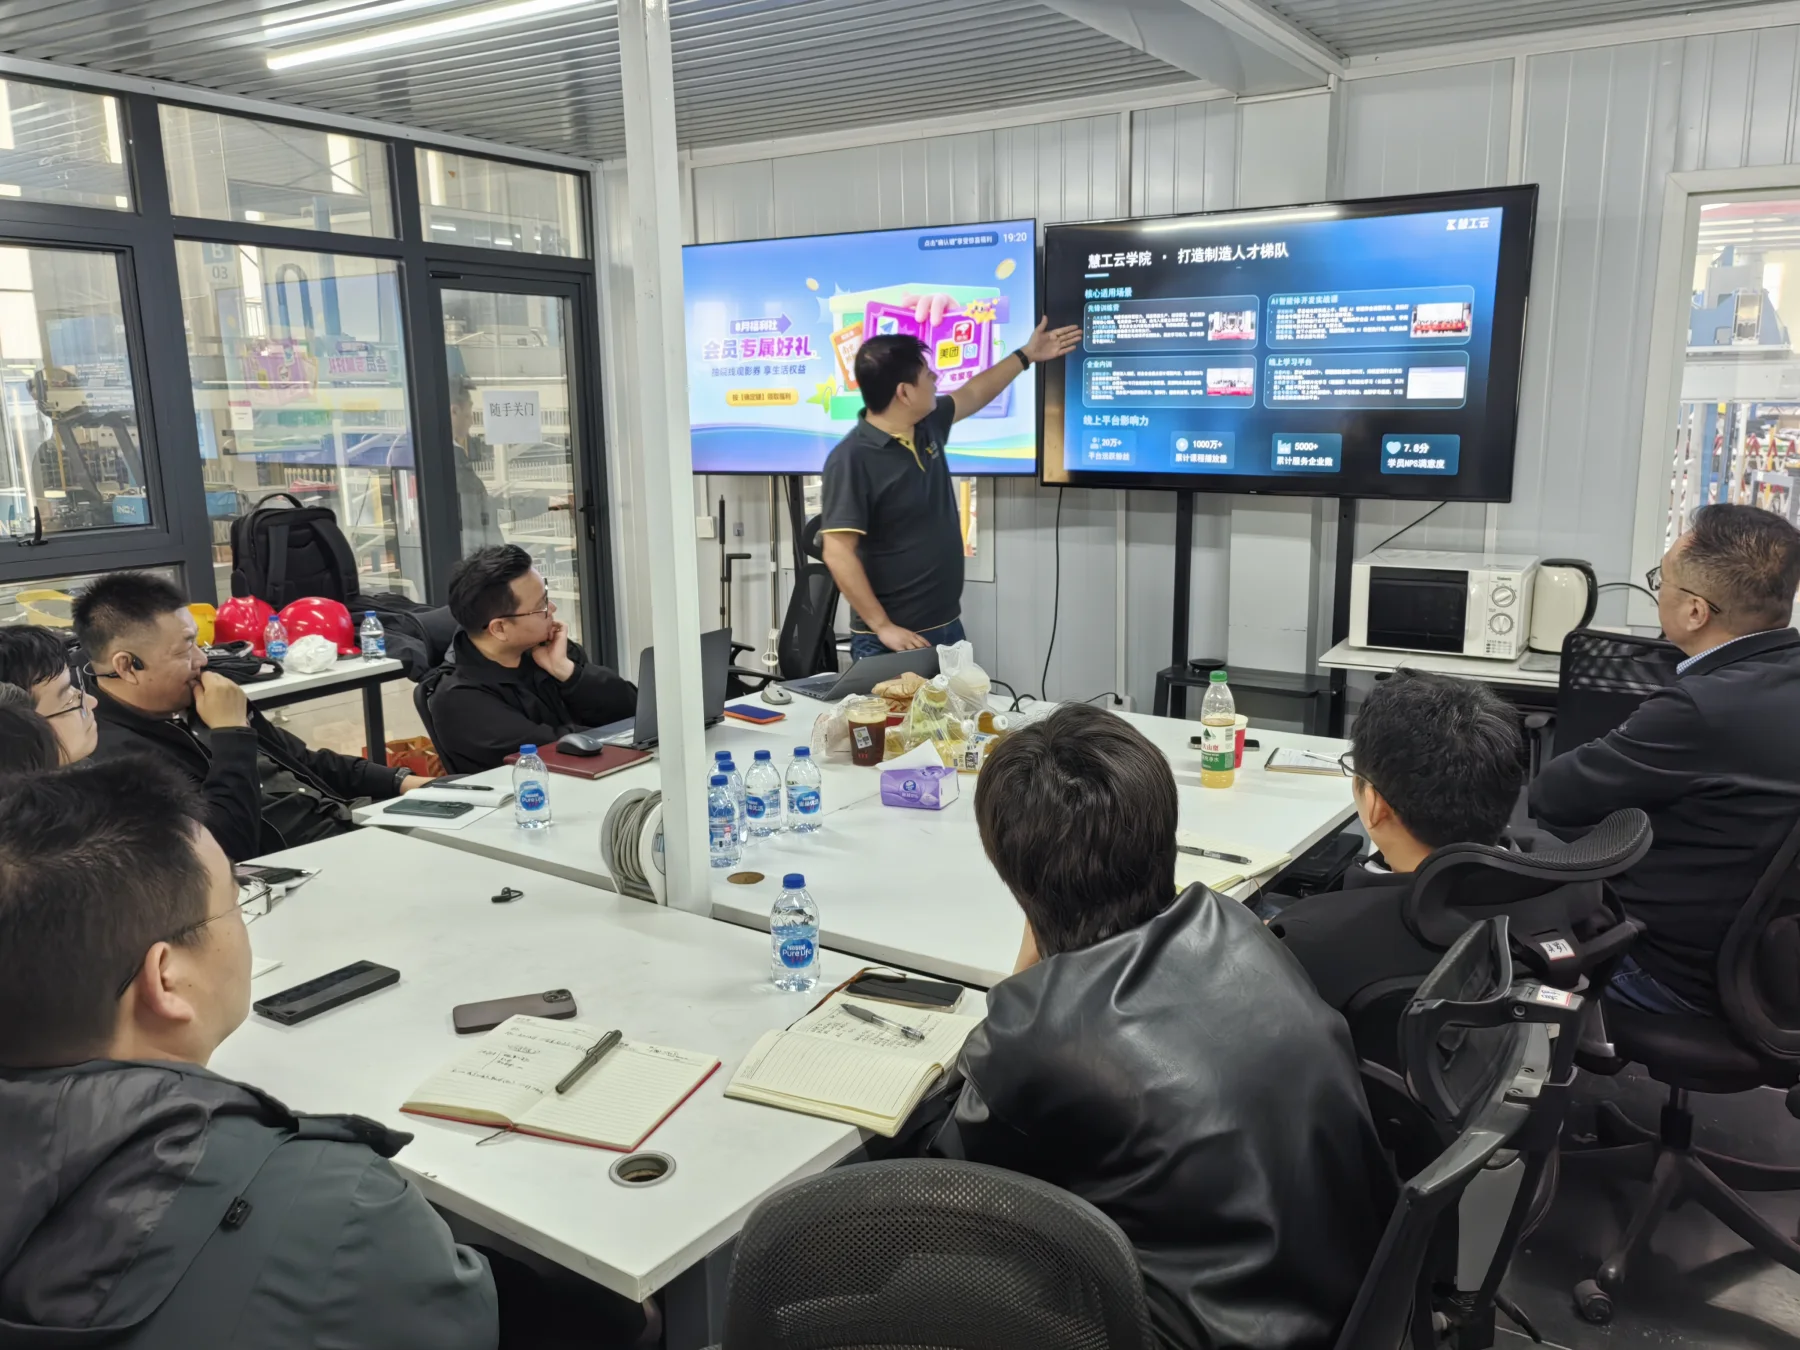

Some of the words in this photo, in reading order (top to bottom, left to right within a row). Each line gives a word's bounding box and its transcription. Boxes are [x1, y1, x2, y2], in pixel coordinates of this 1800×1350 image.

[1003, 232, 1027, 243] 19:20
[1088, 251, 1152, 269] 慧工云学院
[1177, 242, 1289, 265] 打造制造人才梯队
[212, 265, 228, 279] 03
[1084, 287, 1133, 299] 核心适用场景
[703, 336, 812, 359] 会员专属好礼
[940, 346, 959, 359] 美团
[489, 402, 534, 417] 随手关门
[1083, 415, 1149, 427] 线上平台影响力
[1193, 440, 1223, 450] 1000万+
[1294, 442, 1318, 451] 5000+
[782, 949, 800, 957] Pure
[800, 948, 812, 958] Life
